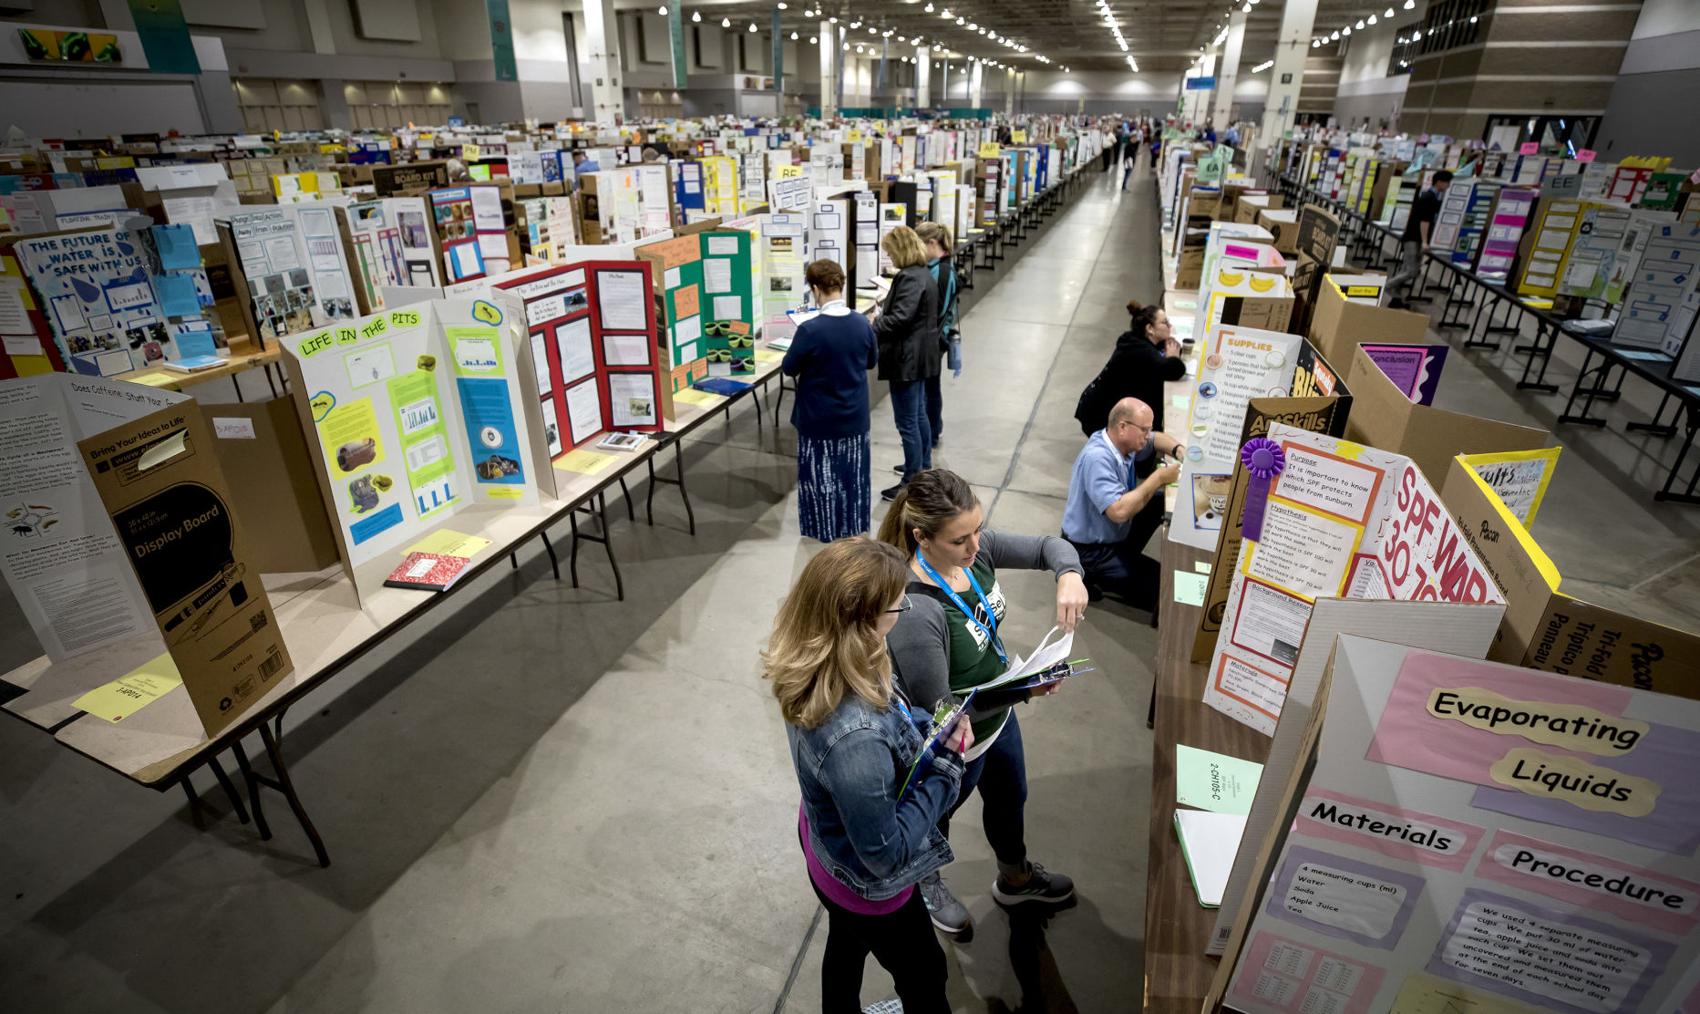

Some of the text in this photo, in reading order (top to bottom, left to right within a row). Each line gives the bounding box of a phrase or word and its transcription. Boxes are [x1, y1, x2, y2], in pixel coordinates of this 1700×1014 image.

[29, 232, 130, 253] THE FUTURE OF
[49, 250, 93, 264] WATER
[54, 264, 86, 277] SAFE
[125, 256, 141, 266] US
[301, 313, 418, 356] LIFE IN THE PITS
[1228, 338, 1272, 352] SUPPLIES
[72, 383, 90, 393] Does
[1250, 413, 1327, 433] ArtSkills
[90, 417, 184, 459] Bring Your Ideas to Life
[1290, 453, 1318, 467] Purpose
[1285, 472, 1305, 483] which
[1321, 484, 1353, 498] protects
[1304, 467, 1339, 484] important
[1341, 478, 1349, 486] to
[1350, 482, 1369, 493] know
[1283, 482, 1353, 508] people from sunburn
[135, 527, 183, 558] Display
[182, 504, 219, 533] Board
[1398, 466, 1497, 604] SPF WAR
[1480, 520, 1500, 544] Pacon
[1385, 520, 1411, 586] 30
[1533, 613, 1570, 664] Panneau
[1561, 622, 1596, 666] Triptico
[1585, 629, 1622, 677] Tri-Fold
[1434, 692, 1641, 750] Evaporating
[1210, 763, 1221, 801] 2-CH105-C
[1512, 759, 1632, 802] Liquids
[1311, 802, 1451, 851] Materials
[1293, 886, 1315, 896] Soda
[1298, 875, 1325, 887] Water
[1311, 868, 1354, 884] measuring
[1356, 879, 1376, 890] cups
[1379, 884, 1398, 895] (ml)
[1512, 850, 1684, 909] Procedure
[1287, 905, 1303, 914] Tea
[1290, 895, 1339, 913] Apple Juice
[1482, 907, 1498, 917] We
[1502, 912, 1525, 925] used
[1539, 924, 1584, 941] separate
[1586, 937, 1639, 958] measuring
[1497, 931, 1522, 945] apple
[1524, 939, 1549, 953] juice
[1552, 948, 1572, 959] and
[1506, 924, 1523, 934] We
[1525, 929, 1542, 940] put
[1563, 940, 1576, 949] ml
[1467, 934, 1490, 946] each
[1517, 947, 1534, 958] We
[1537, 952, 1554, 963] set
[1558, 958, 1584, 973] them
[1454, 960, 1470, 969] for
[1472, 965, 1499, 980] seven
[1457, 952, 1468, 960] at
[1470, 954, 1488, 966] the
[1491, 960, 1510, 972] end
[1526, 970, 1550, 983] each
[1552, 978, 1585, 995] school
[1462, 943, 1611, 993] uncovered and measured them
